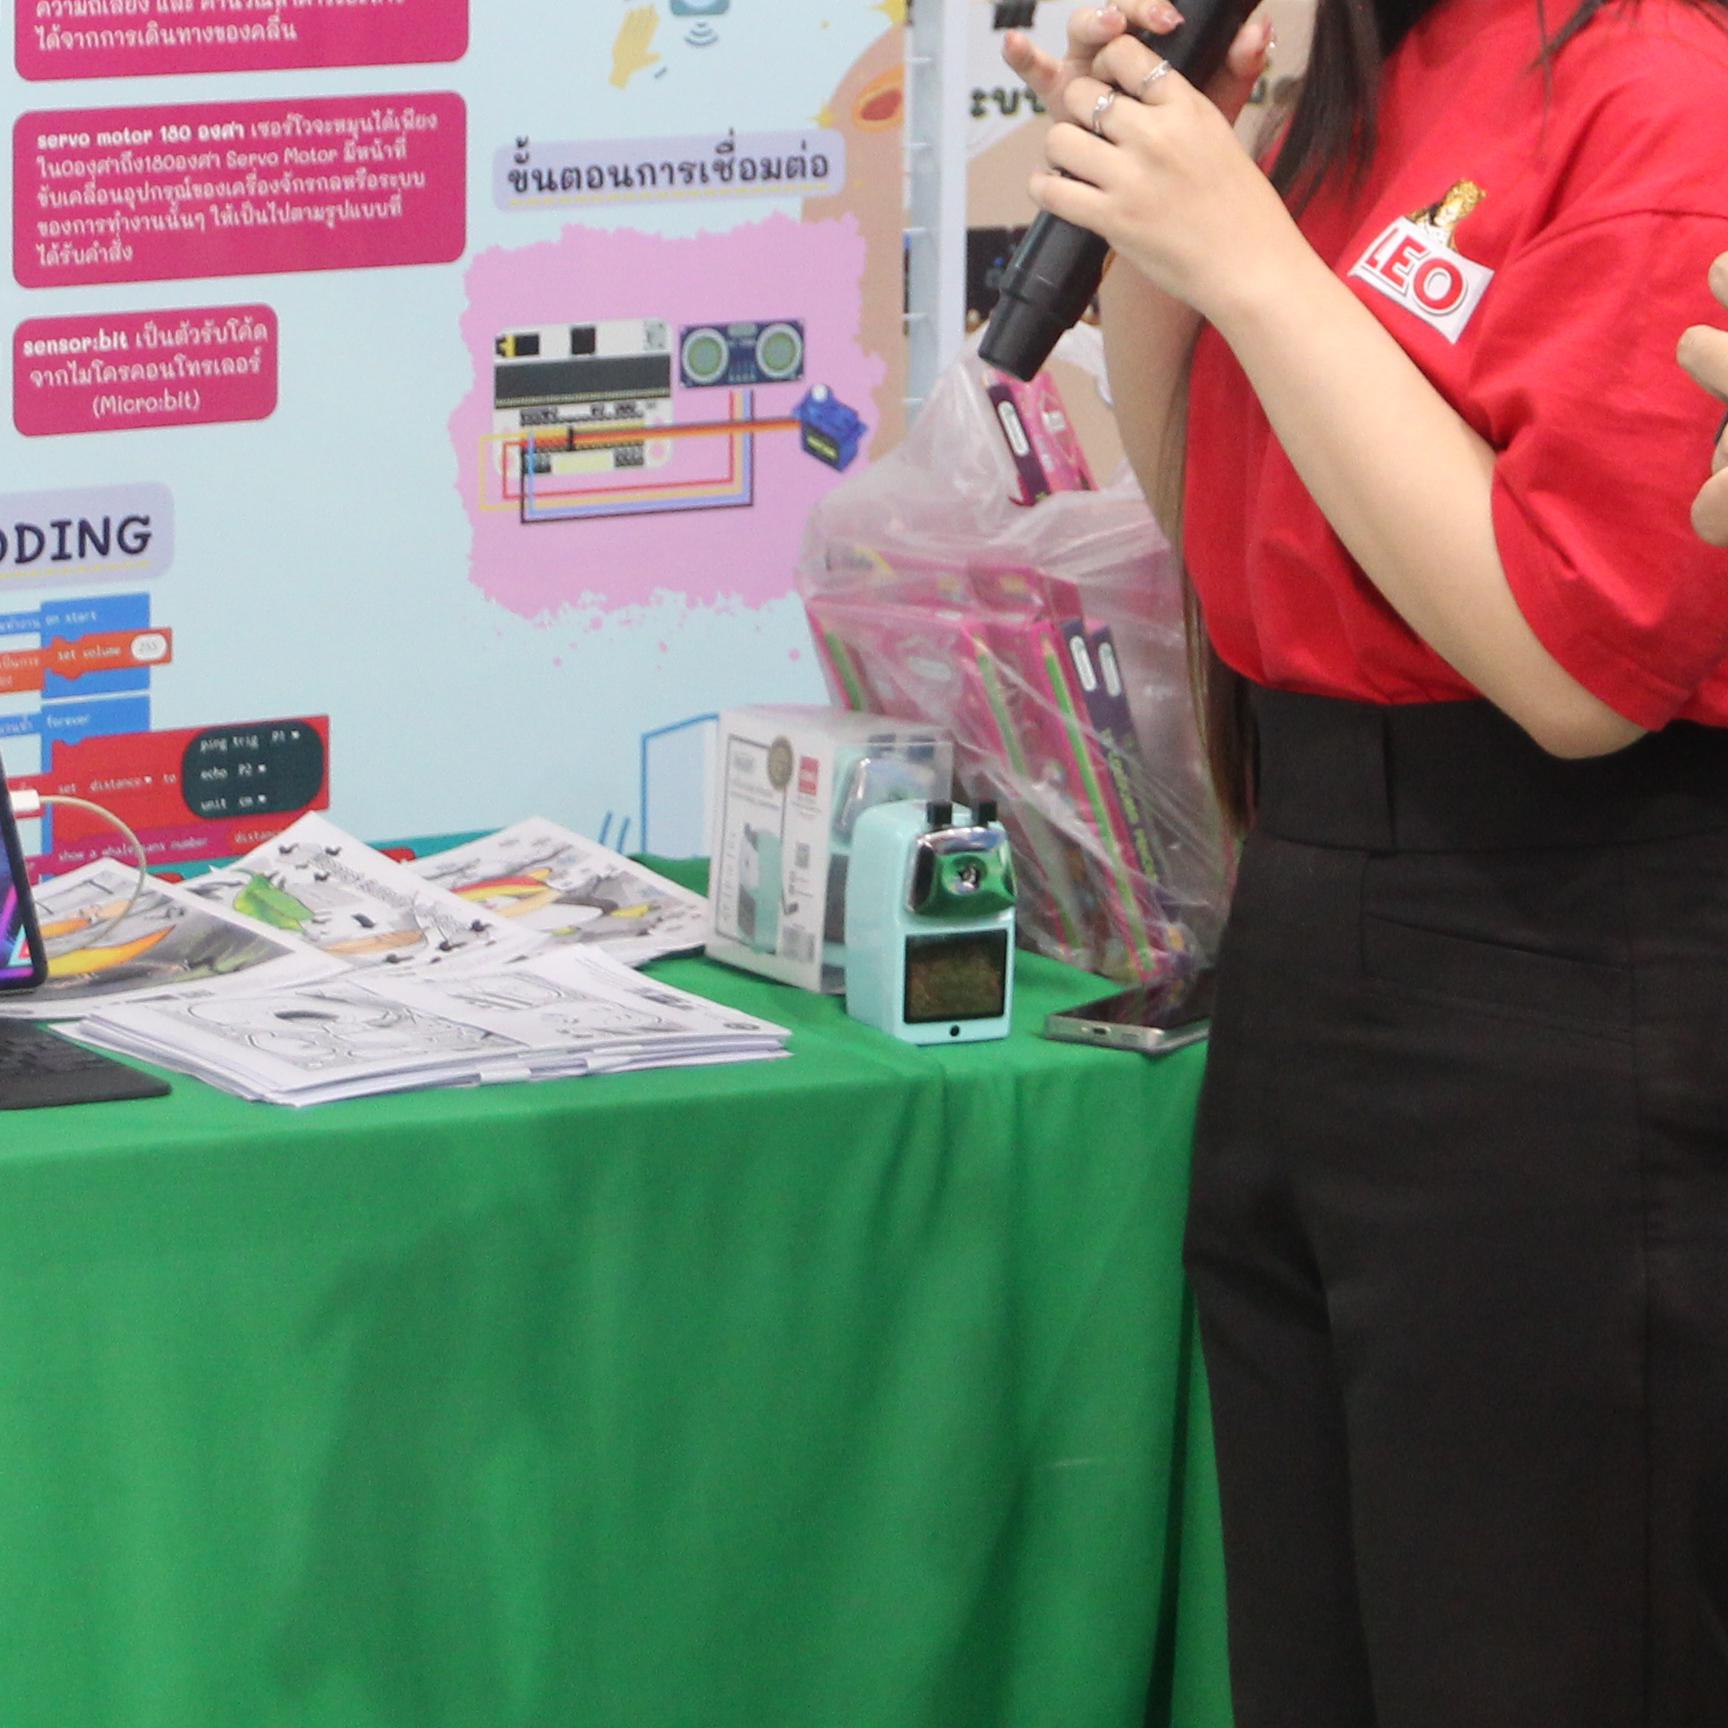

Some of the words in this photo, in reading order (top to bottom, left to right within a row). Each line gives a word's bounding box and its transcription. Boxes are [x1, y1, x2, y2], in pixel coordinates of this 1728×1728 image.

[37, 133, 91, 150] servo
[97, 128, 153, 147] motor
[160, 124, 192, 143] 180
[226, 149, 279, 169] Servo
[284, 147, 338, 165] Motor
[508, 127, 829, 193] ขั้นตอนการเชื่อมต่อ
[1363, 226, 1467, 313] LEO
[23, 328, 129, 358] sensor:bit
[92, 387, 201, 419] (Micro:bit)
